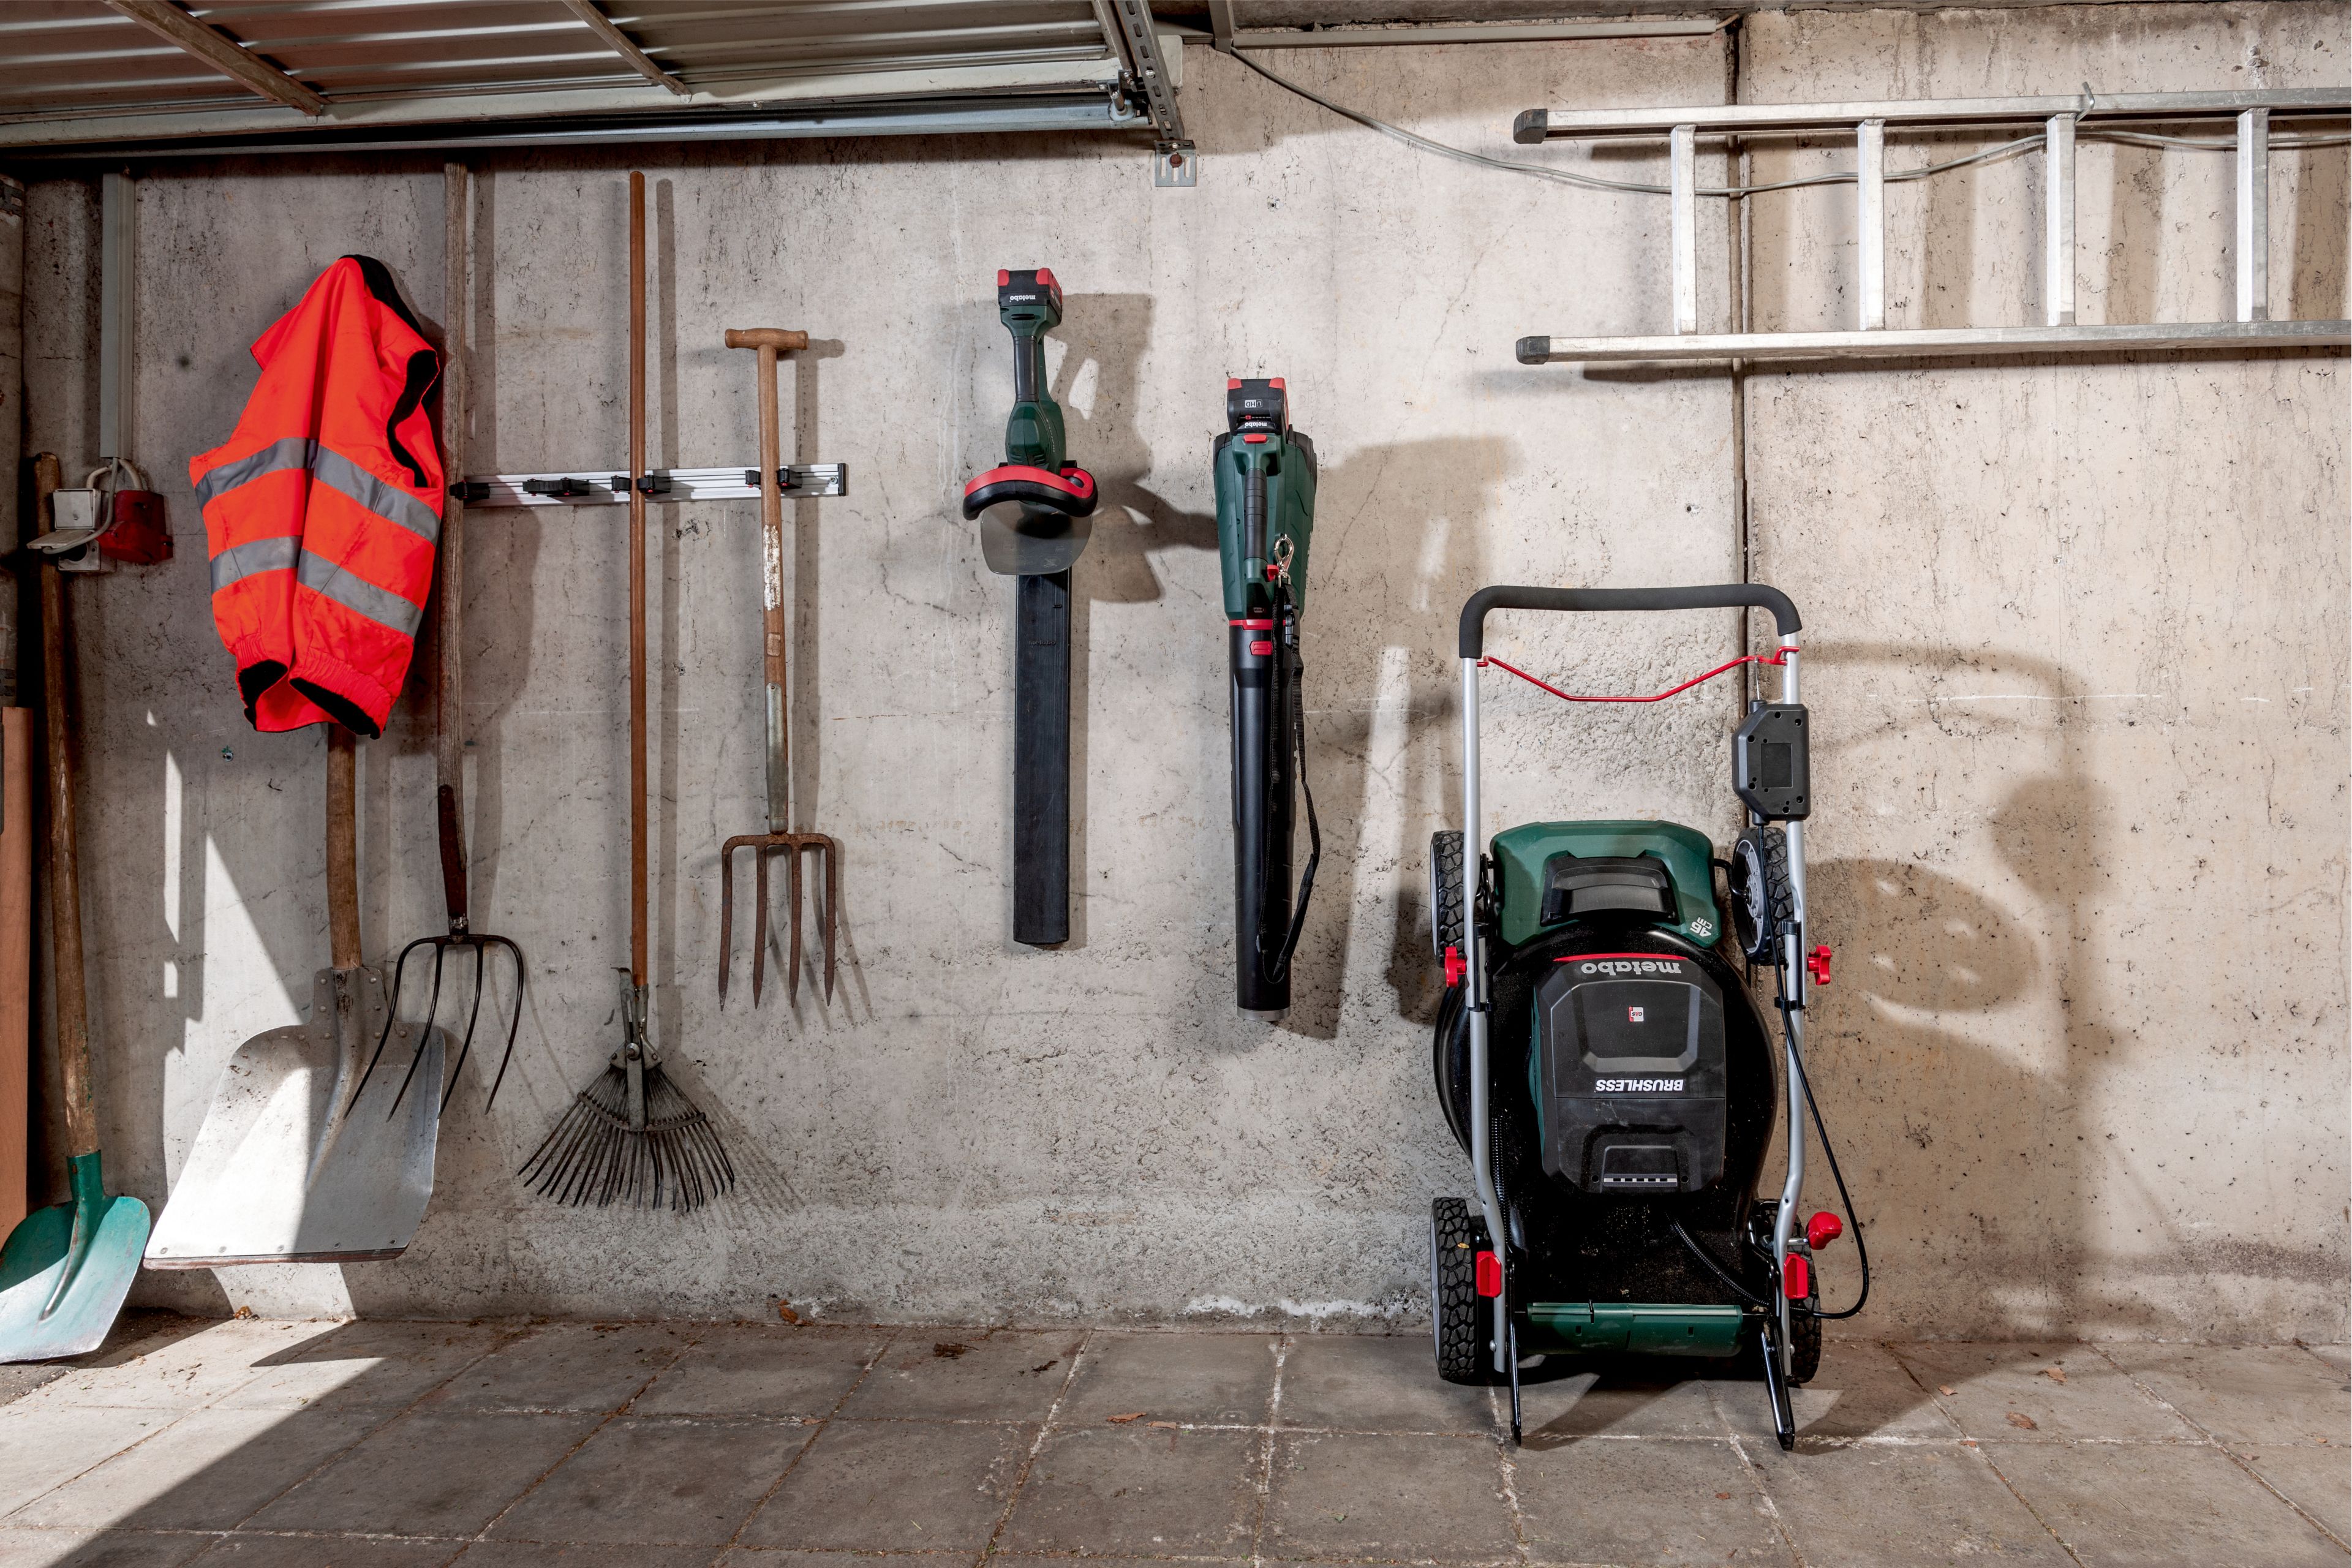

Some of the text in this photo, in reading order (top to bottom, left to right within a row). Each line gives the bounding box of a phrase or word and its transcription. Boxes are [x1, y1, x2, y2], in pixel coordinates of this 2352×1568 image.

[1690, 921, 1711, 937] 46
[1697, 917, 1713, 929] cm
[1581, 961, 1682, 975] metabo
[1596, 1079, 1684, 1092] BRUSHLESS
